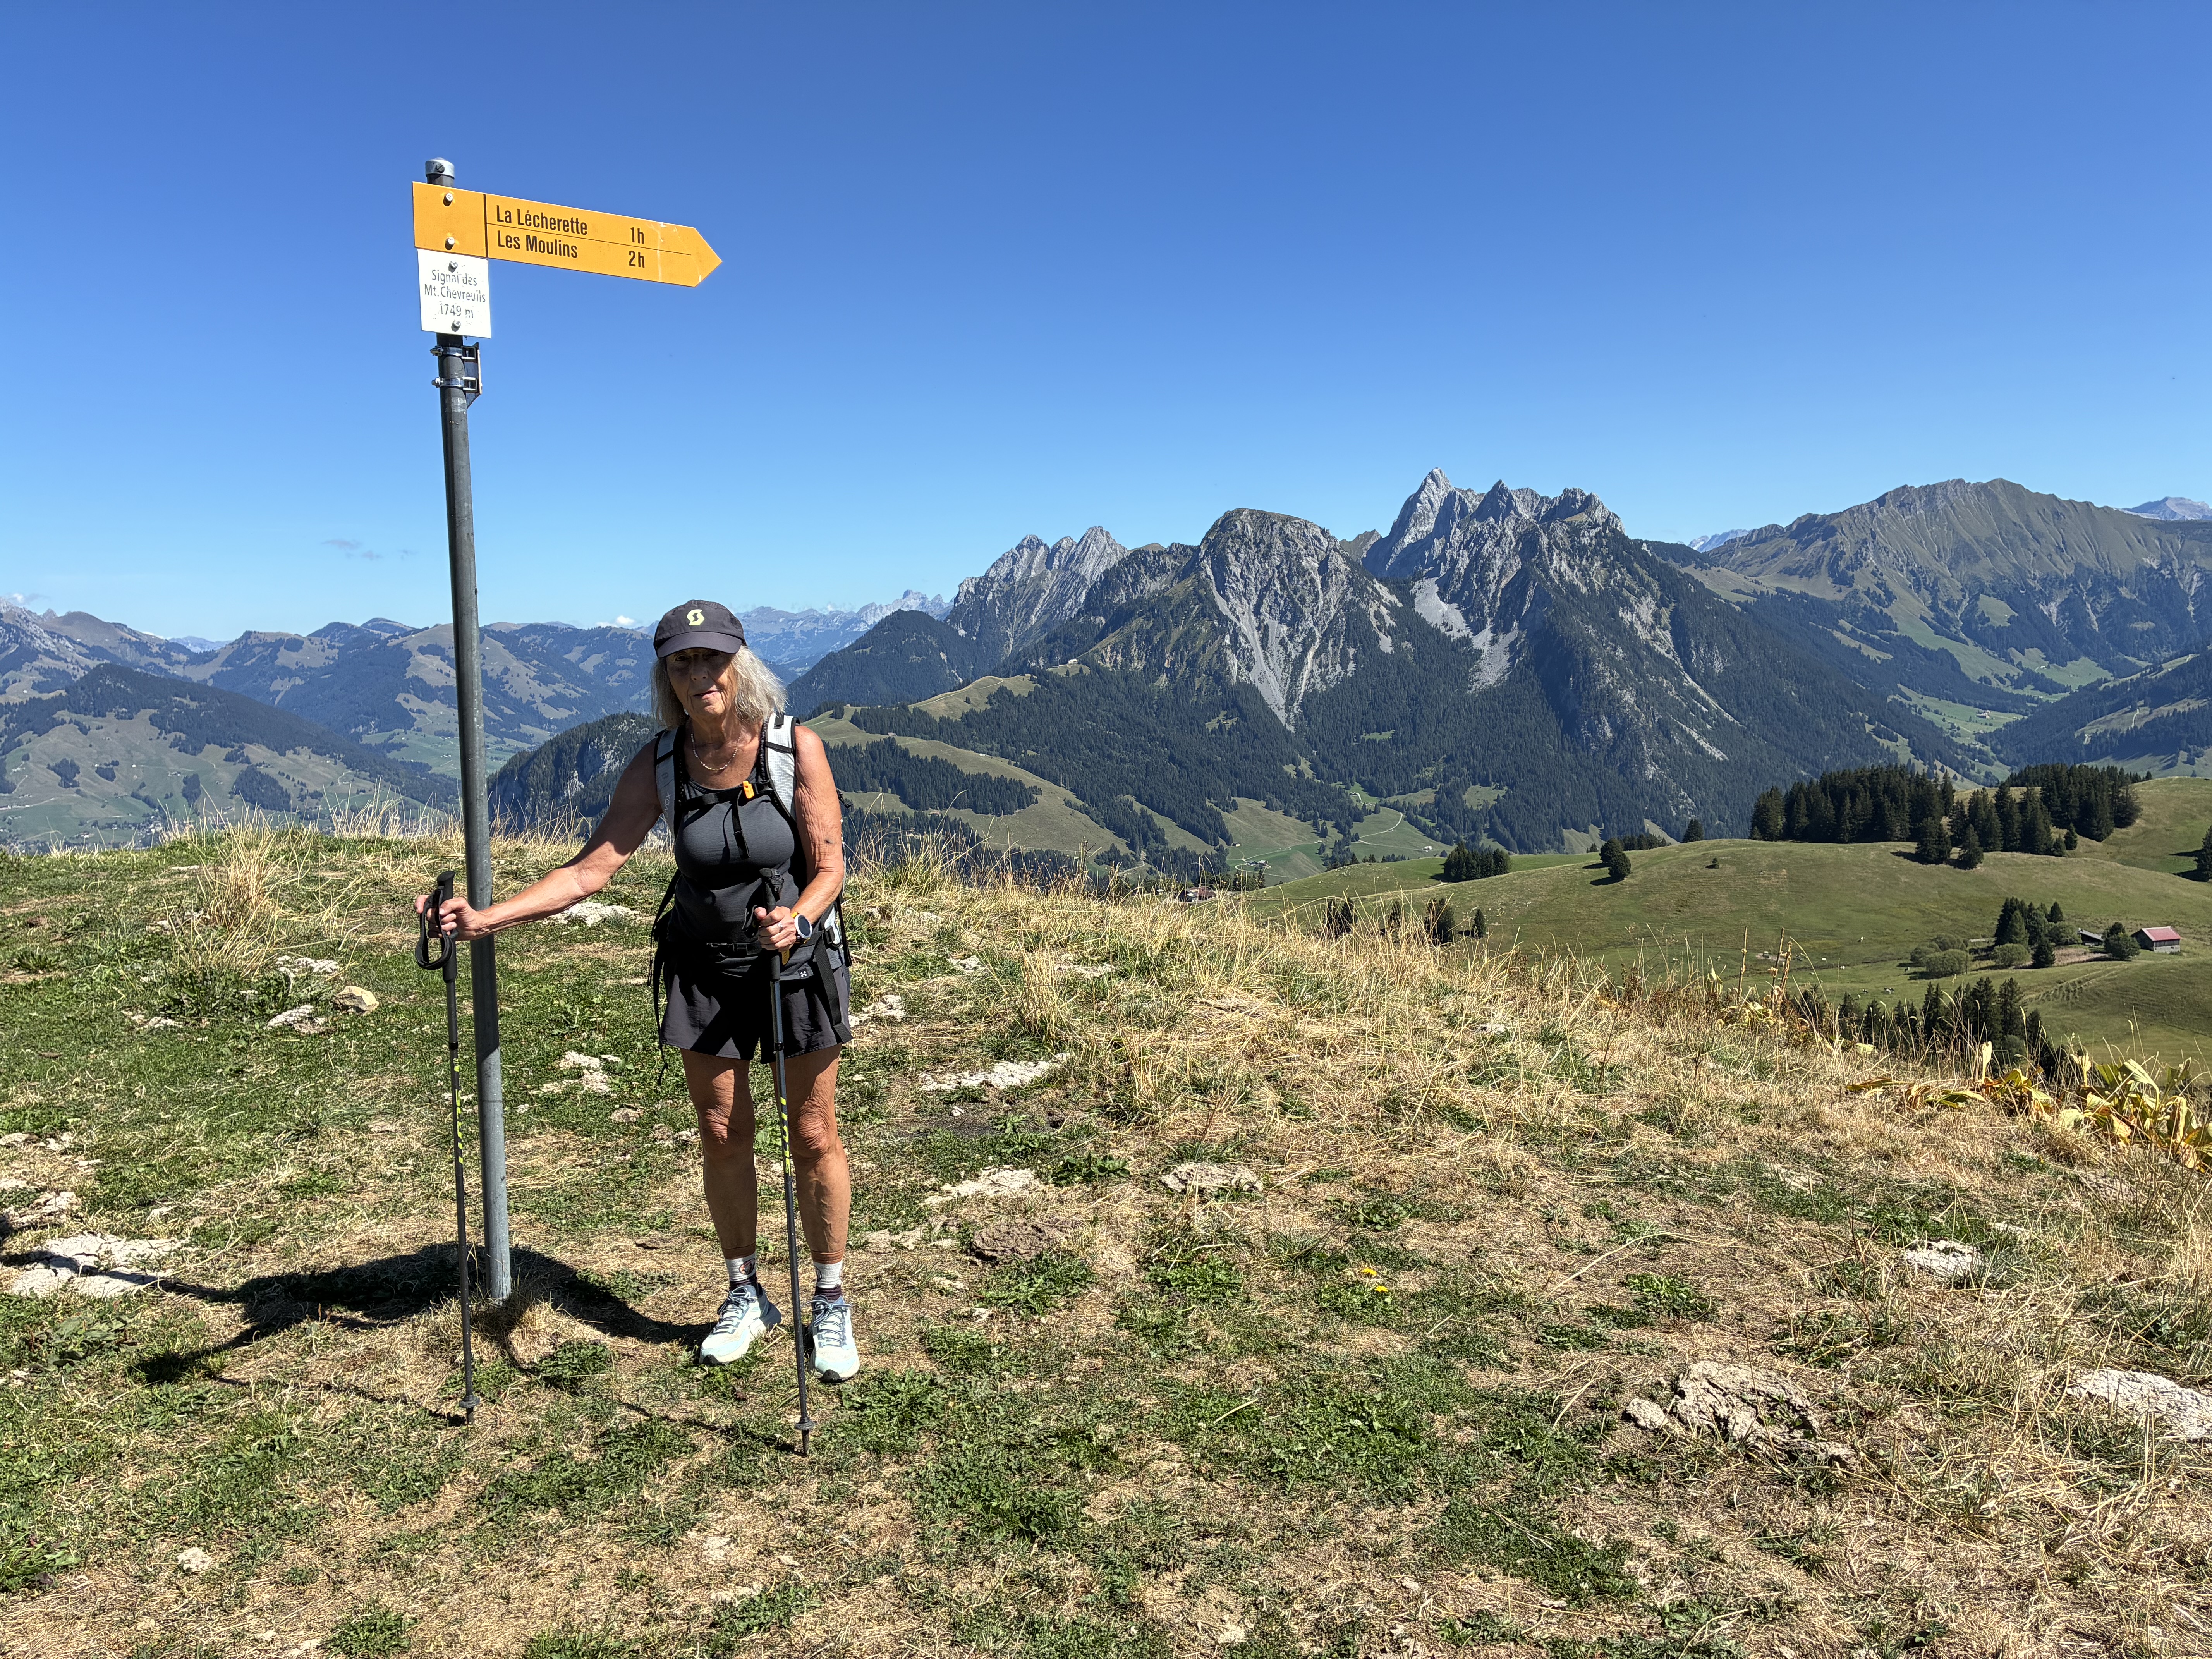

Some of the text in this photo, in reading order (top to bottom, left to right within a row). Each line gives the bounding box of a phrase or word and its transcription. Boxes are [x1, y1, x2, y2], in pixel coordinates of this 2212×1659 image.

[496, 205, 587, 235] La Lécherette
[497, 230, 578, 258] Les Moulins
[630, 227, 644, 244] 1h
[629, 250, 645, 268] 2h
[432, 269, 477, 286] Signal des
[440, 286, 486, 302] Chevreuils
[440, 303, 473, 318] 1749 m
